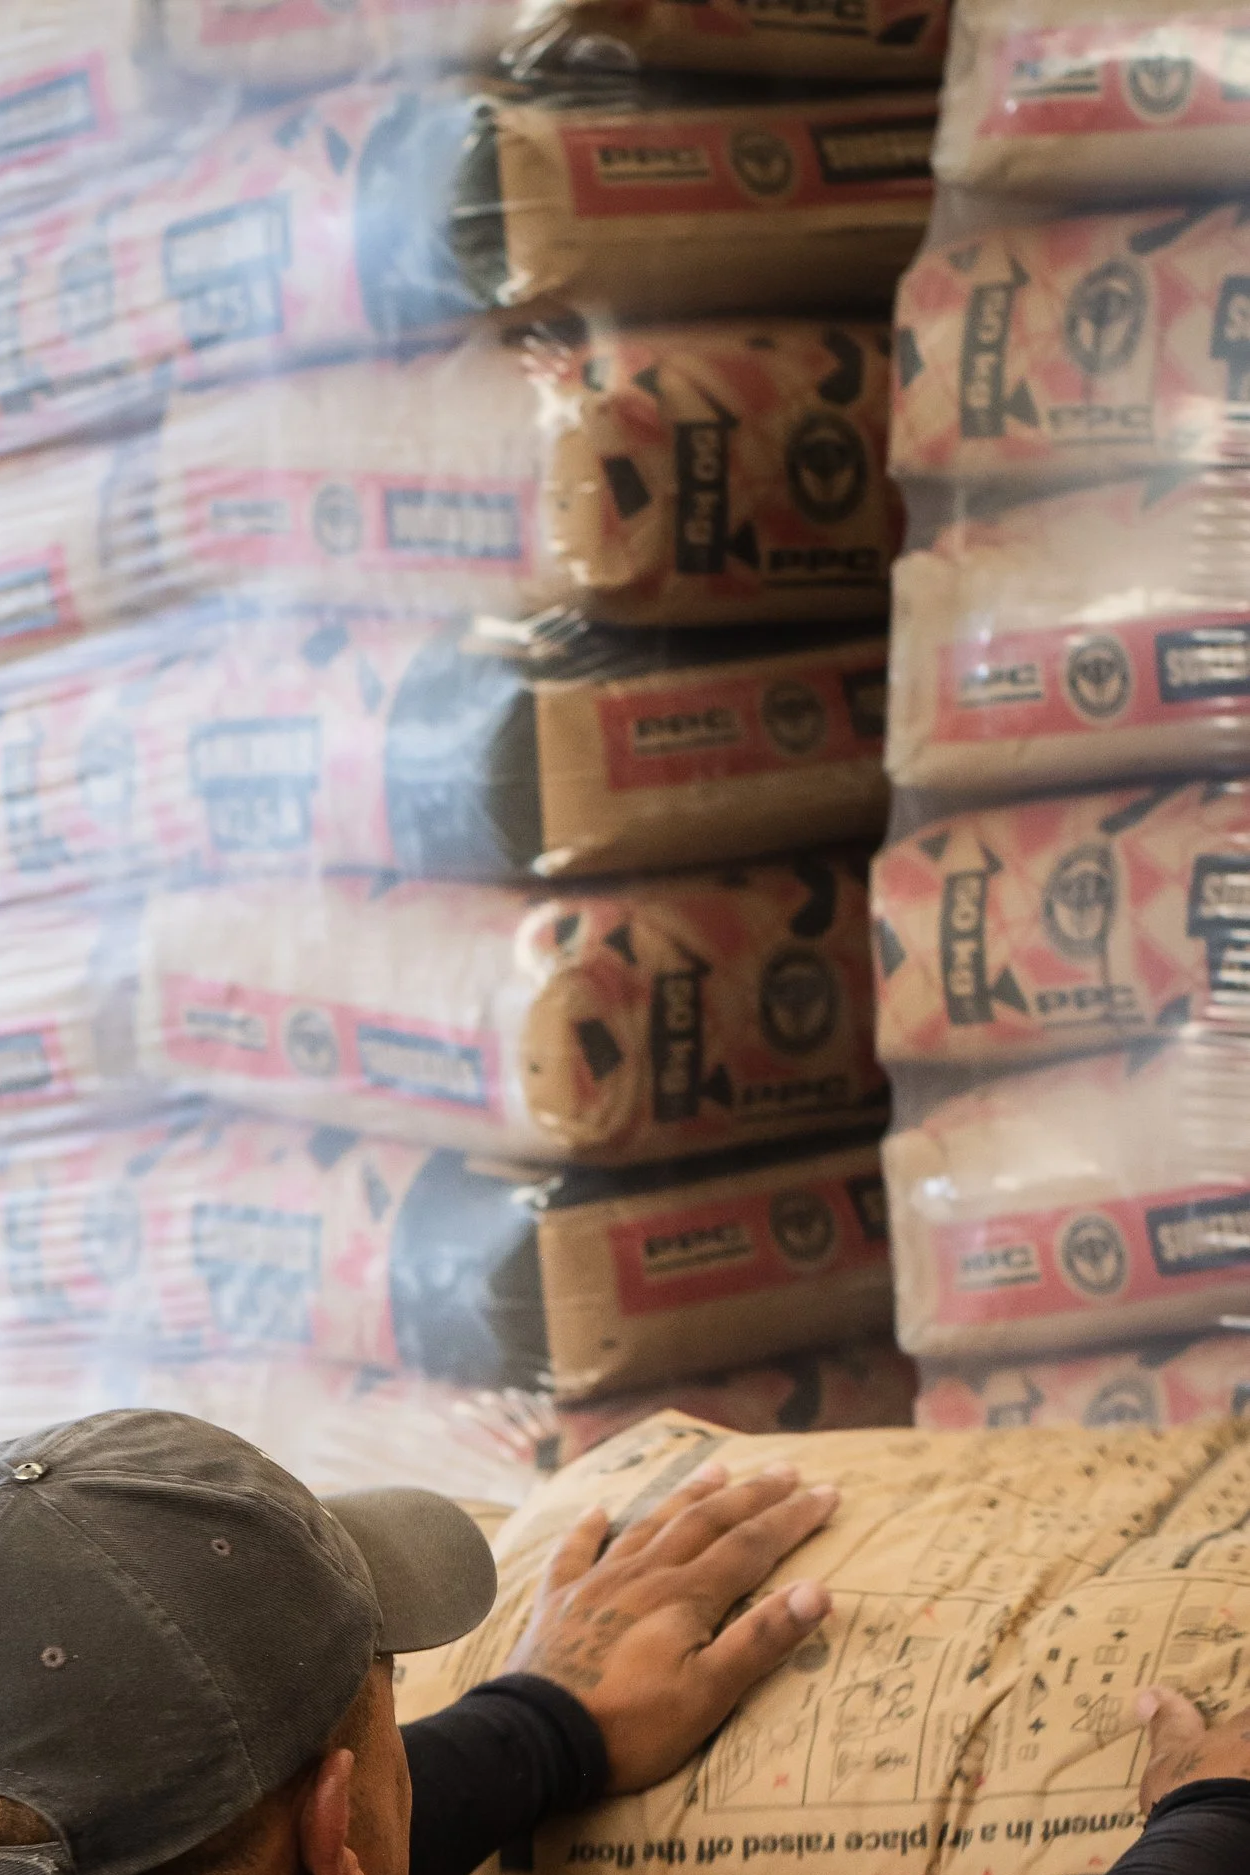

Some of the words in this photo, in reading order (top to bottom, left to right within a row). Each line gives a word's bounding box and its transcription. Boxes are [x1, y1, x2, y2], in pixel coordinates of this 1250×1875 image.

[845, 1822, 929, 1856] place
[981, 1822, 998, 1845] a
[1005, 1819, 1033, 1846] in
[566, 1841, 636, 1868] floor
[642, 1840, 687, 1868] the
[695, 1838, 734, 1867] off
[742, 1834, 836, 1862] raised
